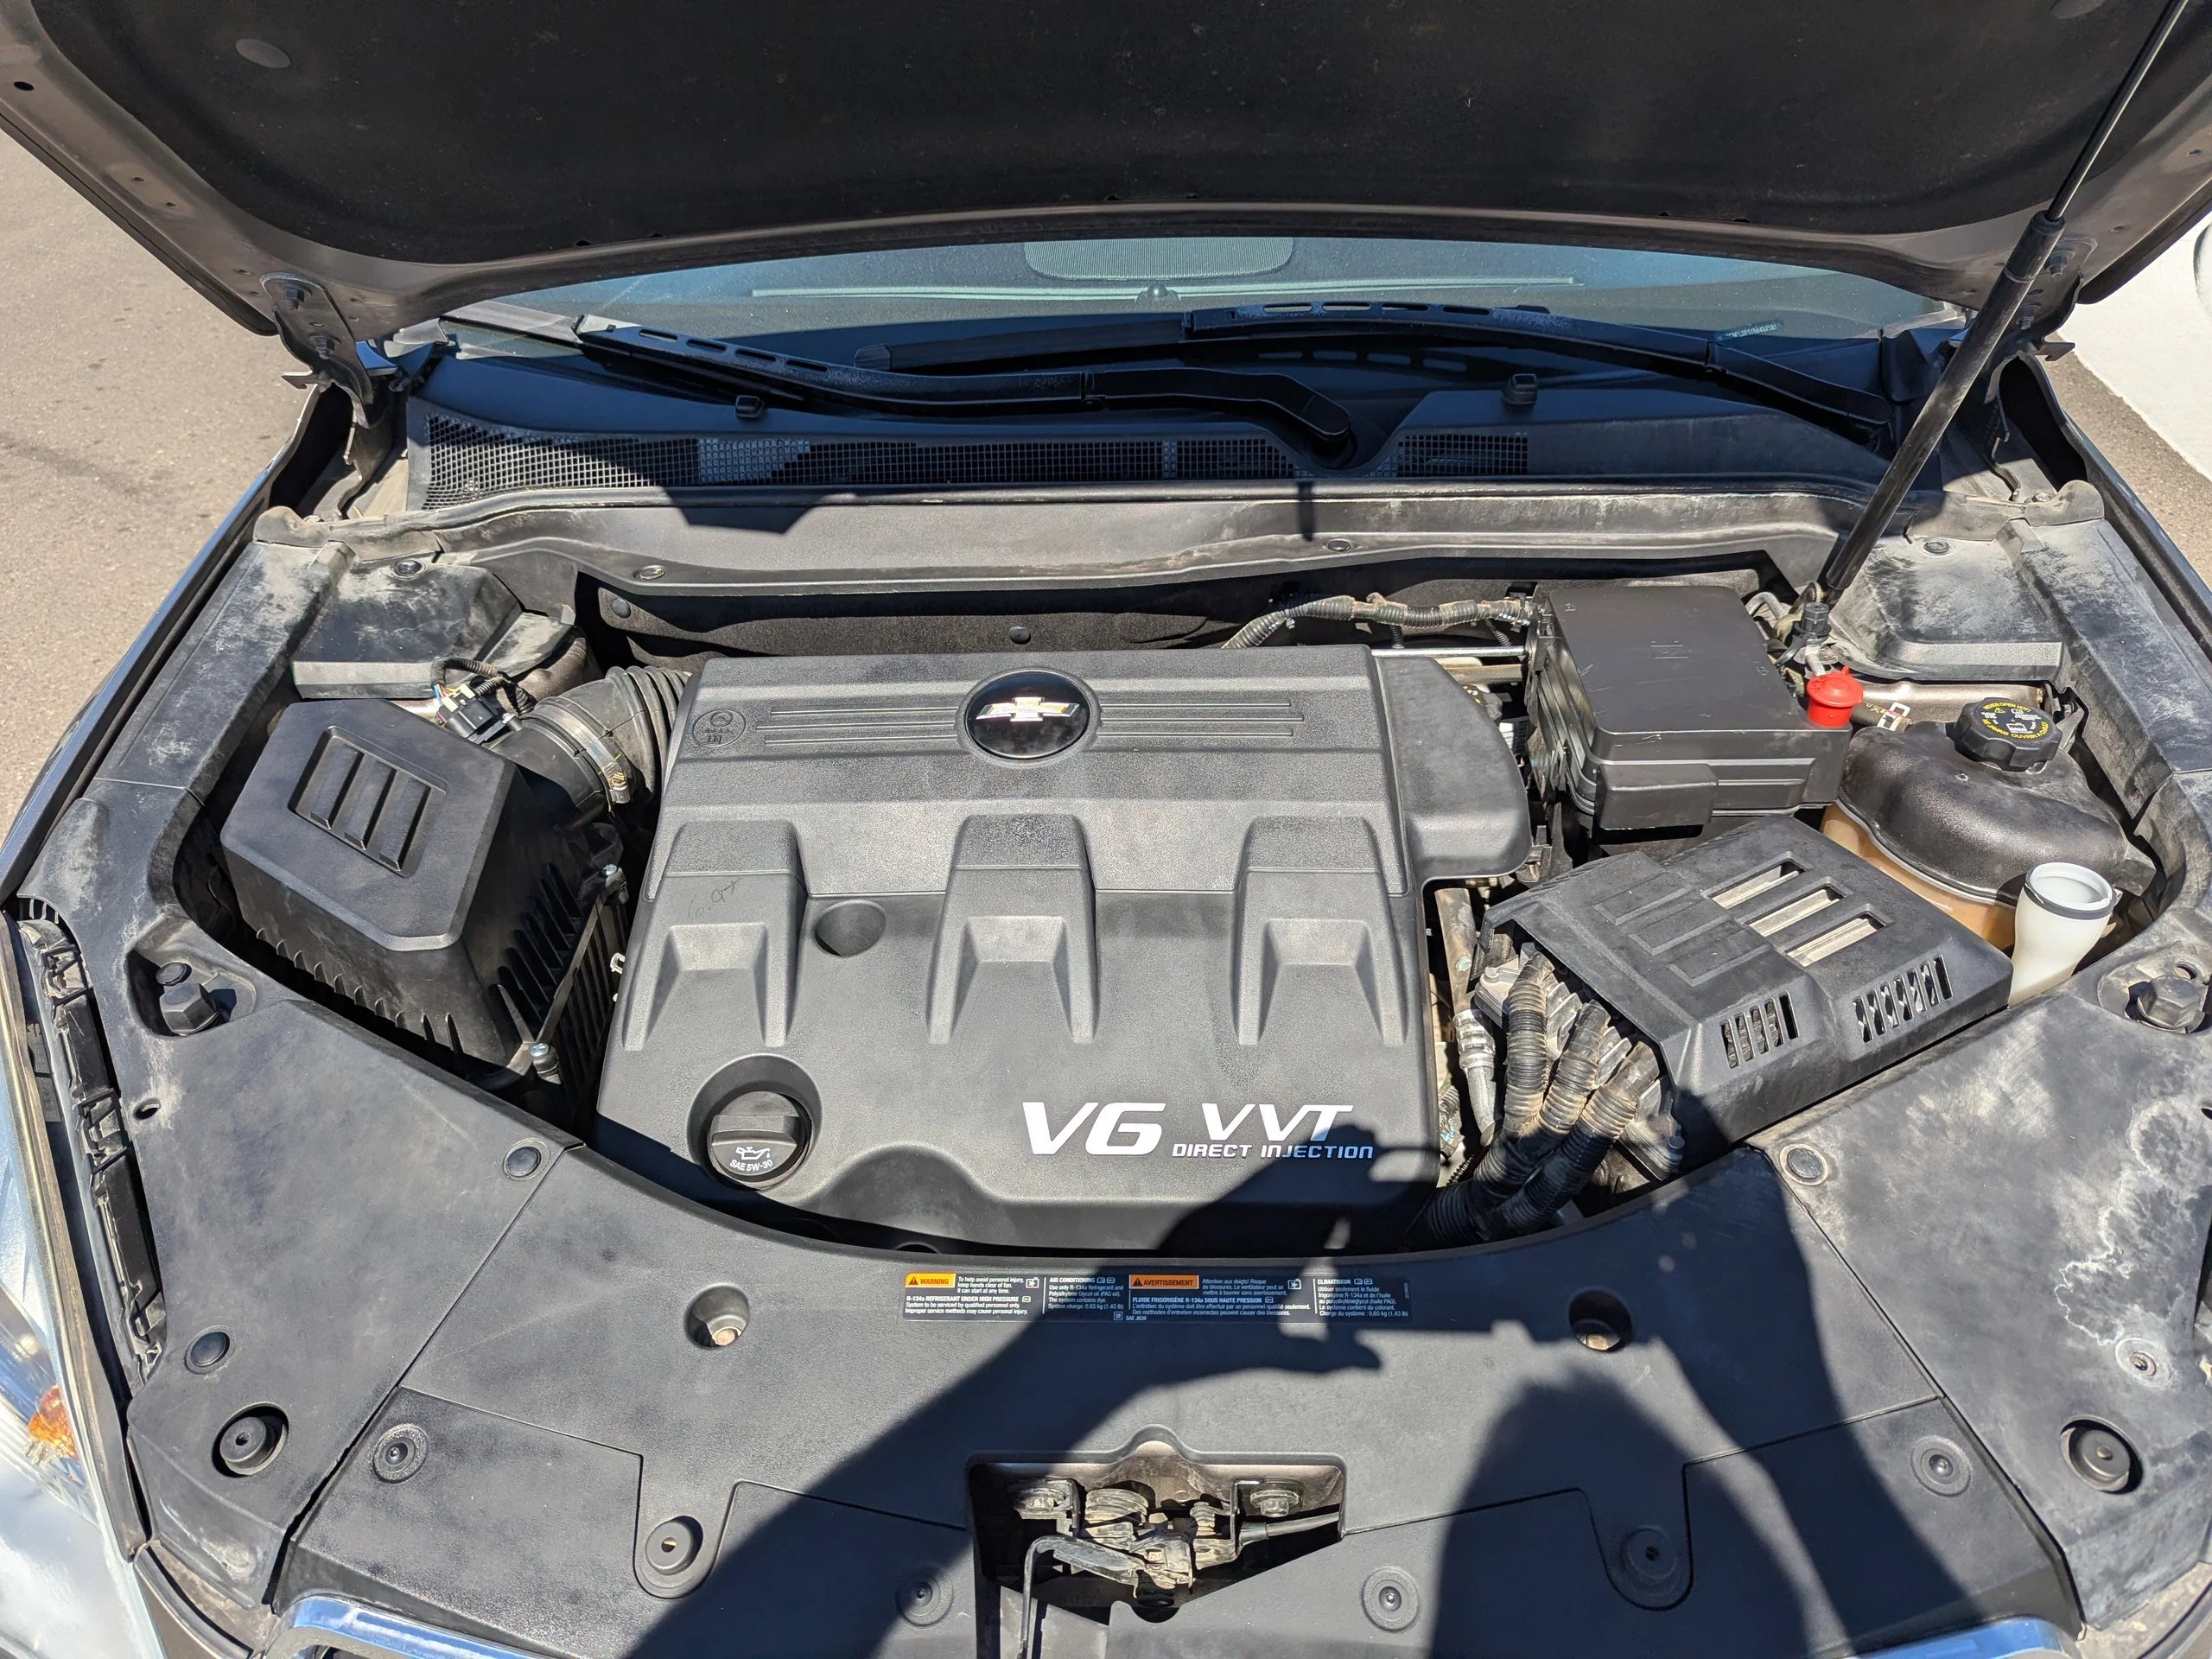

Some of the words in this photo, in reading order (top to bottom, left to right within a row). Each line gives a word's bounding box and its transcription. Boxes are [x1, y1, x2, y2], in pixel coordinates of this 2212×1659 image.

[1987, 724, 2009, 736] JAMAIS
[1022, 1102, 1166, 1155] V6
[1201, 1103, 1354, 1142] VVT
[1172, 1143, 1253, 1159] DIRECT
[1260, 1143, 1374, 1160] INJECTION
[729, 1159, 747, 1171] SAE
[746, 1159, 773, 1172] 5W-30
